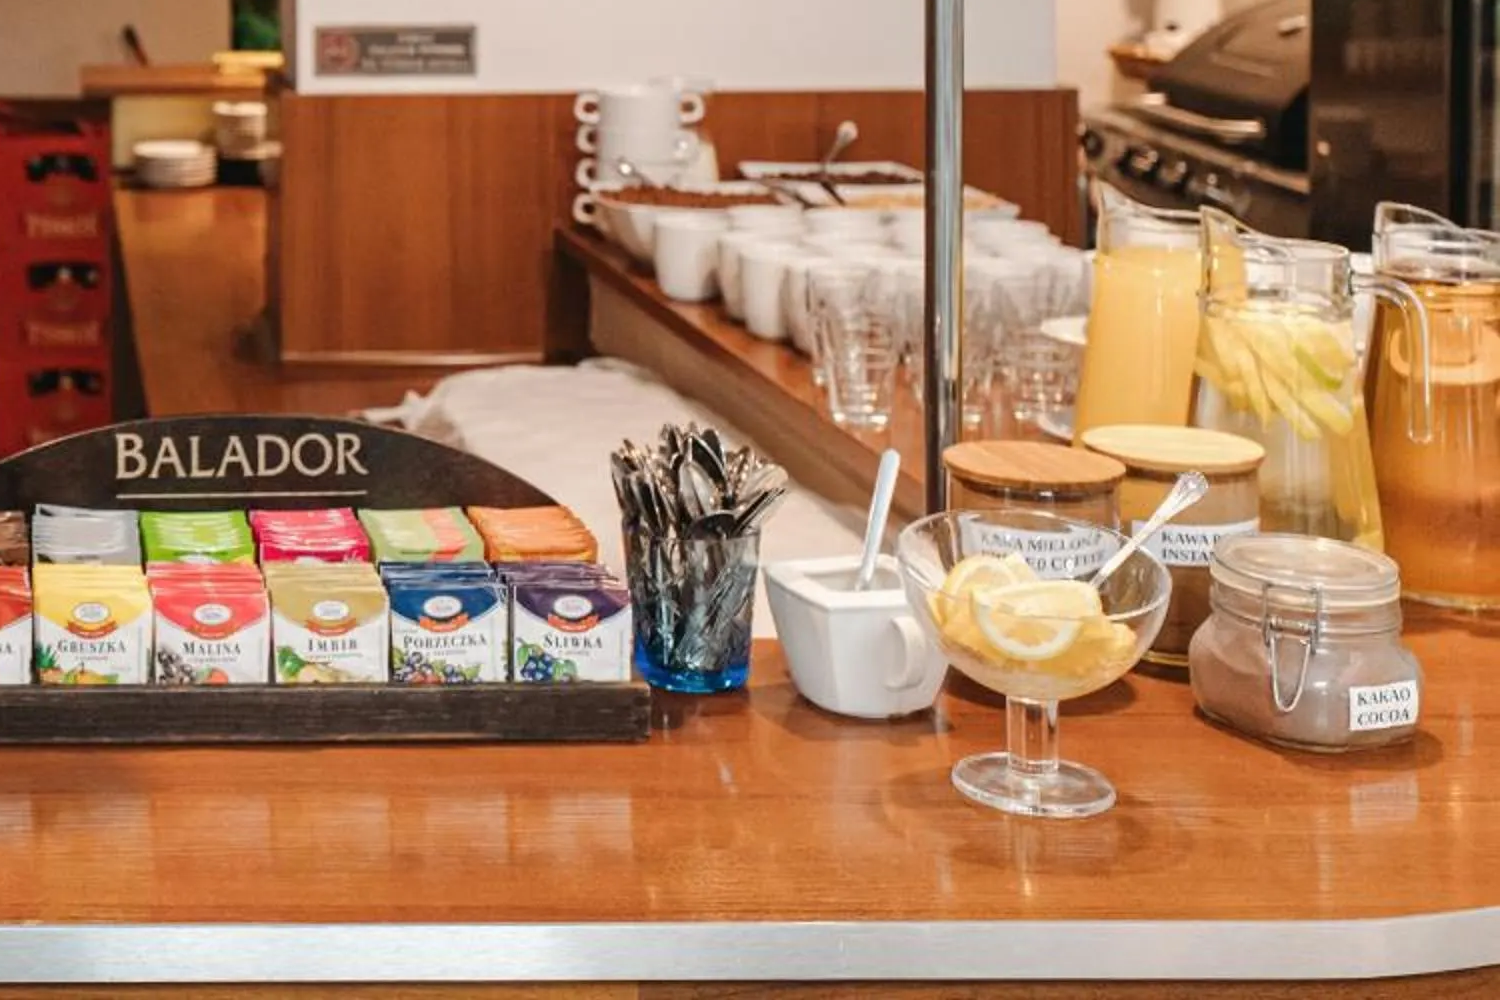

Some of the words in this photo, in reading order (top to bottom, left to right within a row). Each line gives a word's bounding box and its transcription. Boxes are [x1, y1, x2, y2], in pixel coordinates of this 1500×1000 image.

[115, 433, 369, 479] BALADOR
[1162, 531, 1210, 546] KAWA
[57, 639, 127, 653] GRUSZKA
[182, 641, 242, 656] MALINA
[403, 633, 487, 650] PORZECZKA
[1357, 687, 1411, 706] KAKAO
[1357, 709, 1409, 726] COCOA
